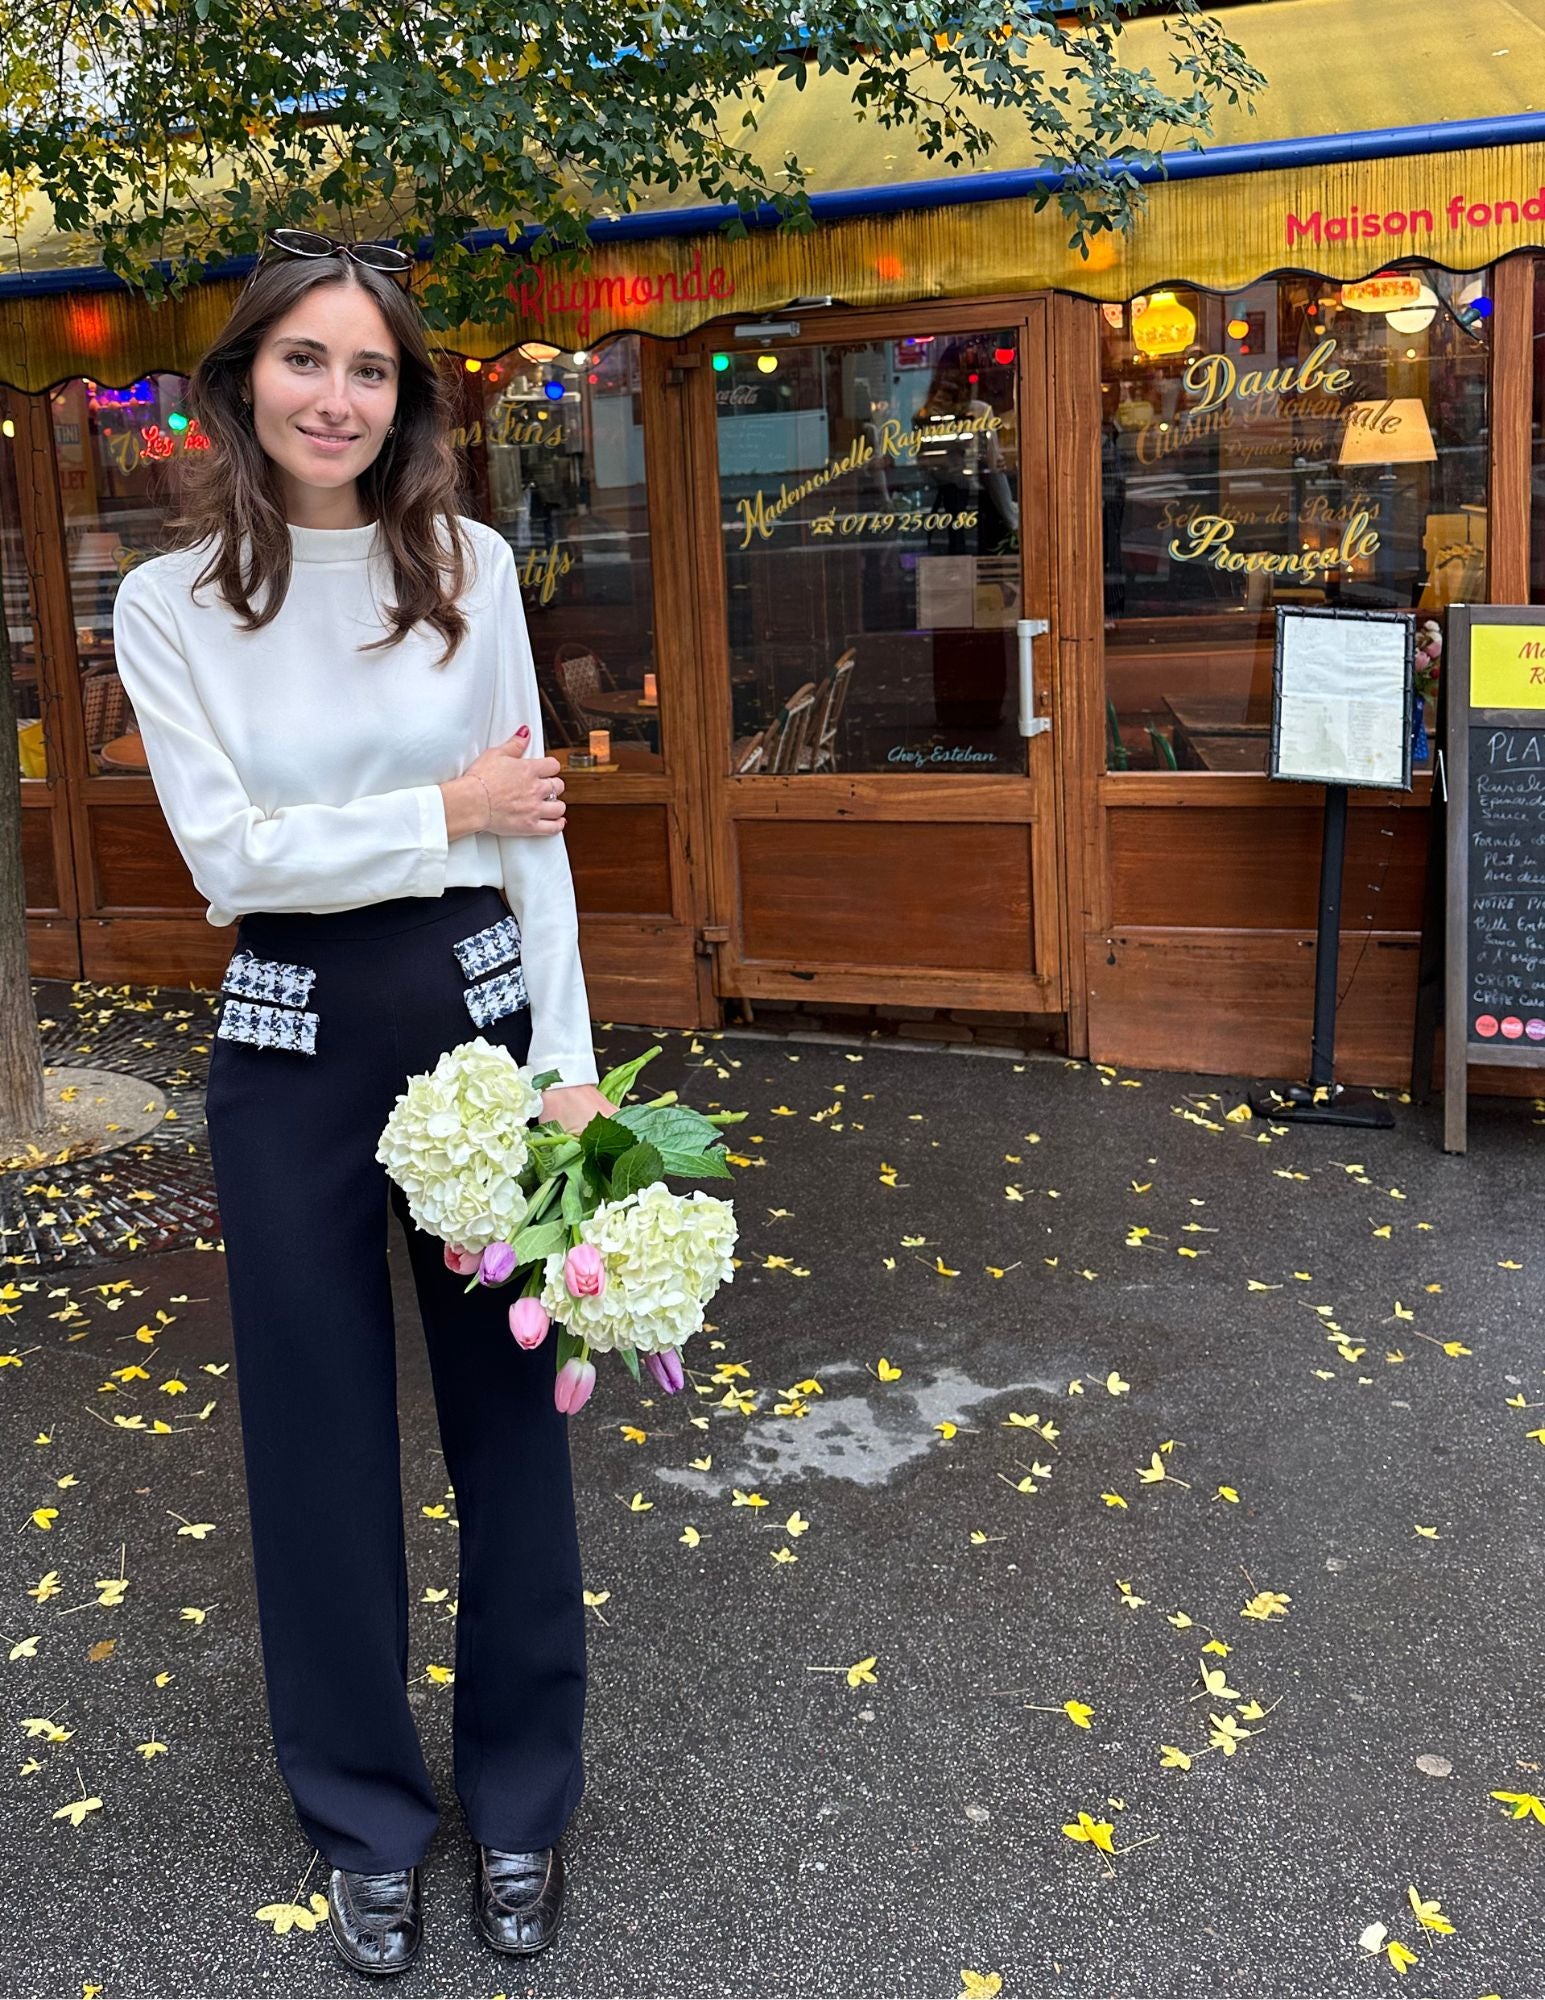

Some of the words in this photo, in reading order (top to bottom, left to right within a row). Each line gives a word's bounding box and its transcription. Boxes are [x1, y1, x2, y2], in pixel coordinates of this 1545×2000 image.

[1287, 205, 1433, 246] Maison
[1446, 187, 1545, 230] fond
[507, 250, 735, 338] Raymonde
[1183, 338, 1354, 417] Daube
[487, 402, 568, 448] Fins
[1287, 436, 1325, 455] 2016
[736, 434, 874, 550] Mademoiselle
[881, 405, 1006, 457] Raymonde
[1264, 503, 1291, 525] de
[1297, 492, 1381, 524] Pastis
[1168, 511, 1382, 584] Provençale
[887, 745, 926, 768] Chez
[930, 745, 998, 763] Esteban
[1487, 731, 1545, 764] PLA
